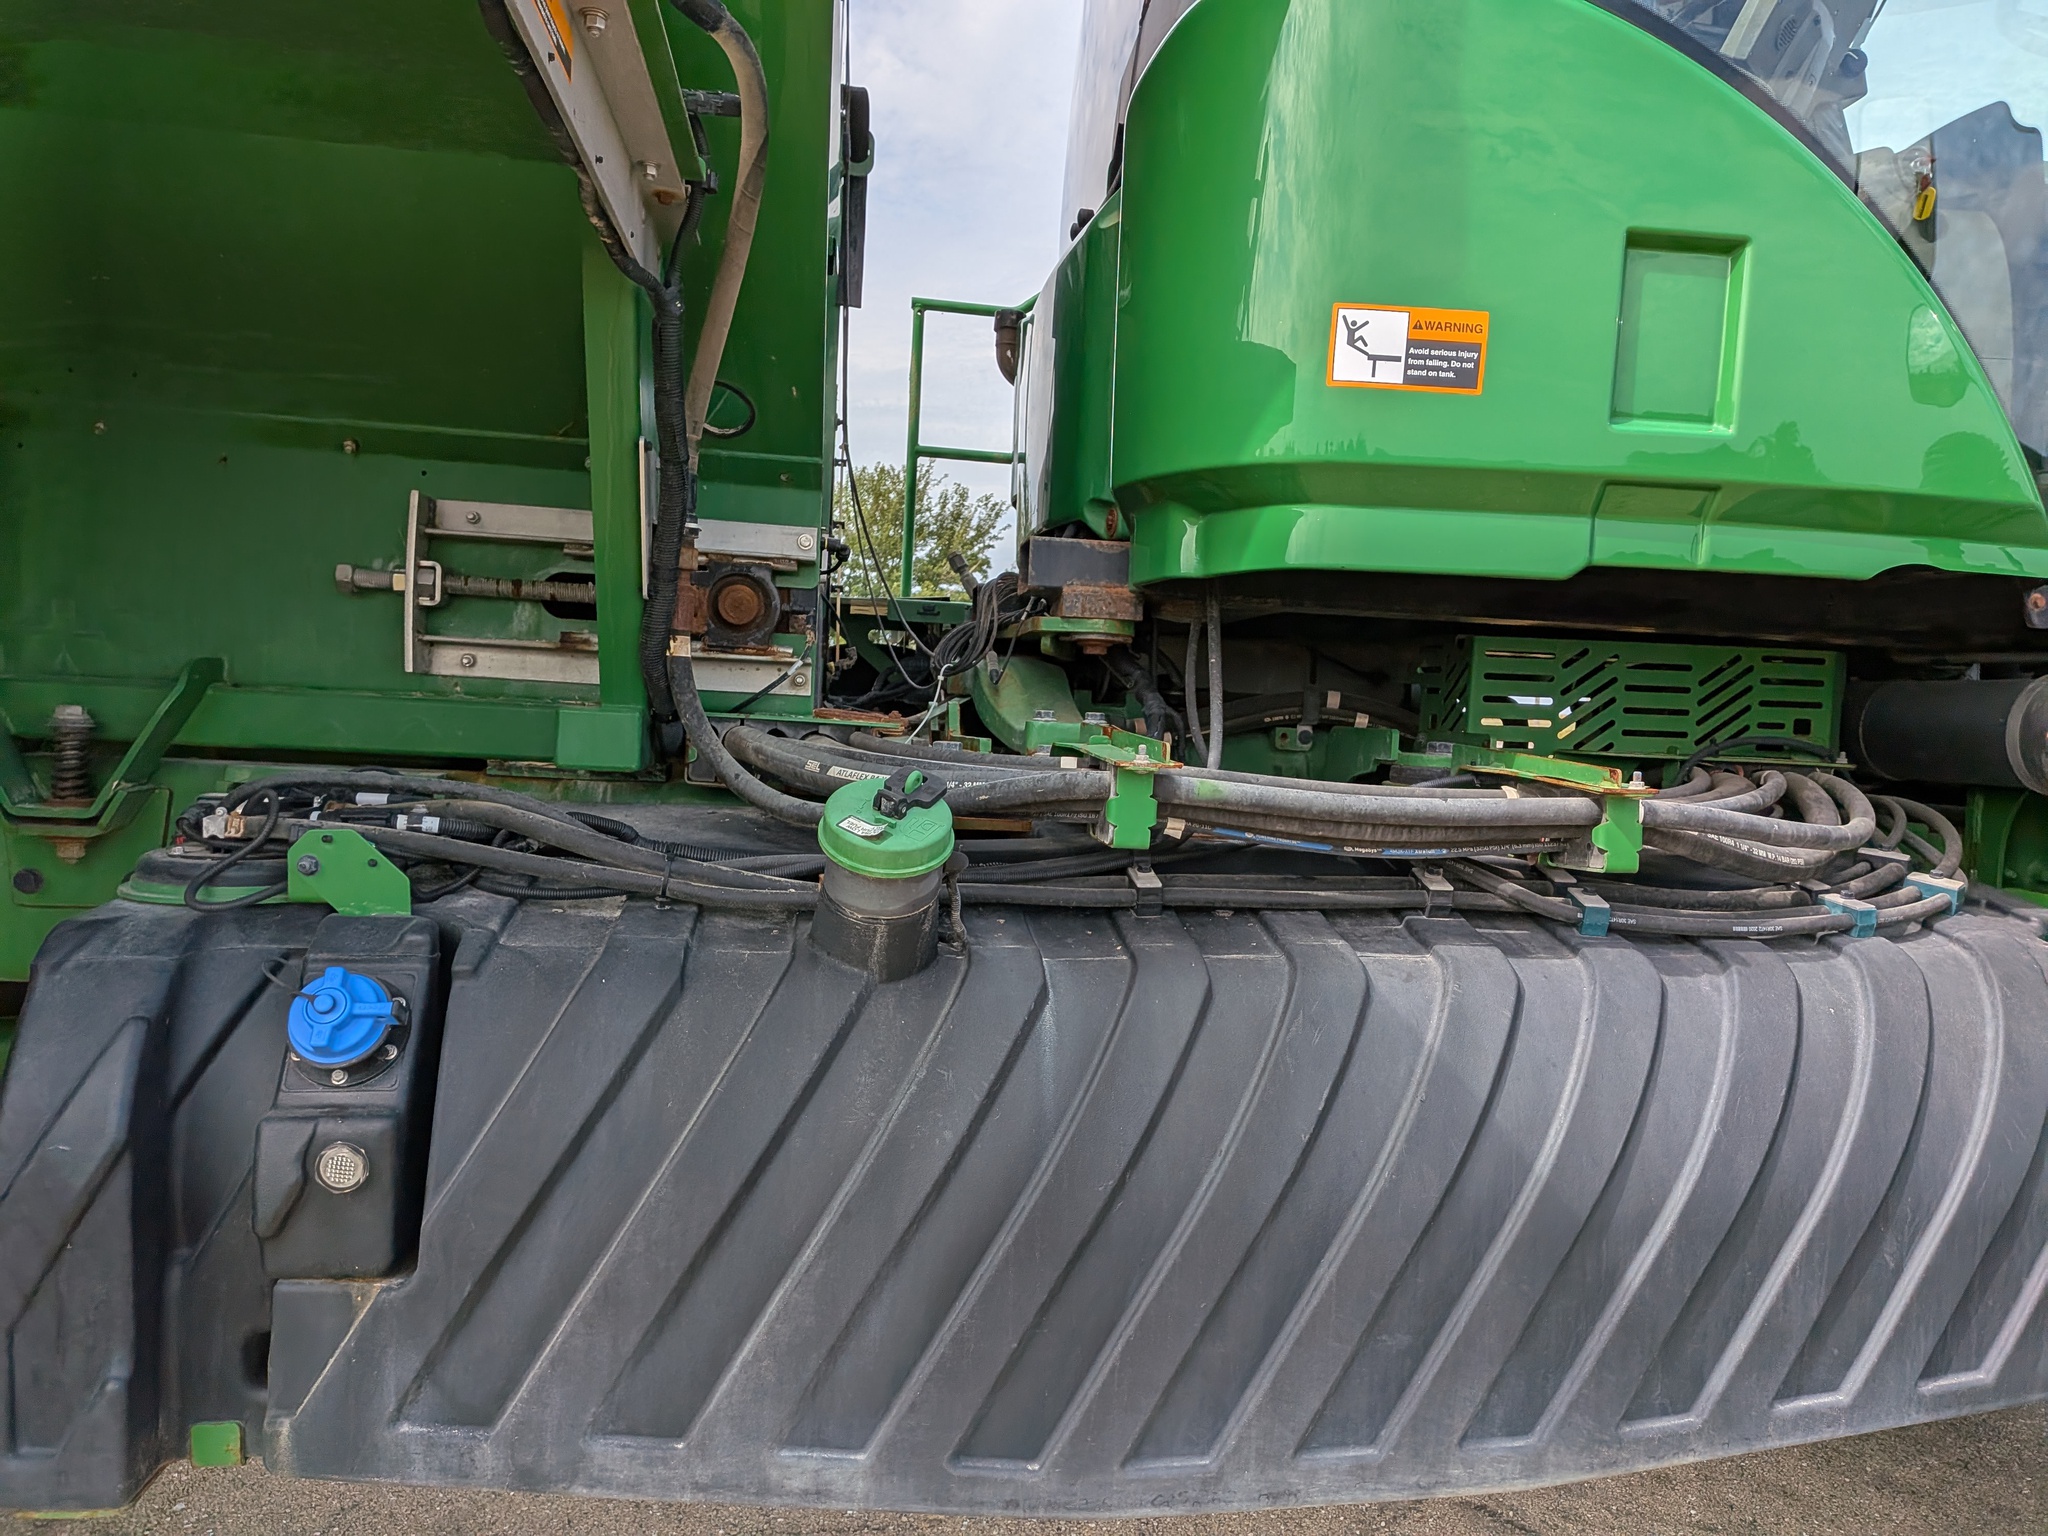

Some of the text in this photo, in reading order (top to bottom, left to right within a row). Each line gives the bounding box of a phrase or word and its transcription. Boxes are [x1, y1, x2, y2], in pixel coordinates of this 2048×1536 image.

[1424, 320, 1483, 333] WARNING
[1409, 347, 1429, 355] Avoid
[1458, 351, 1478, 359] injury
[1426, 359, 1449, 368] falling.
[836, 768, 869, 780] ATLAFLEX
